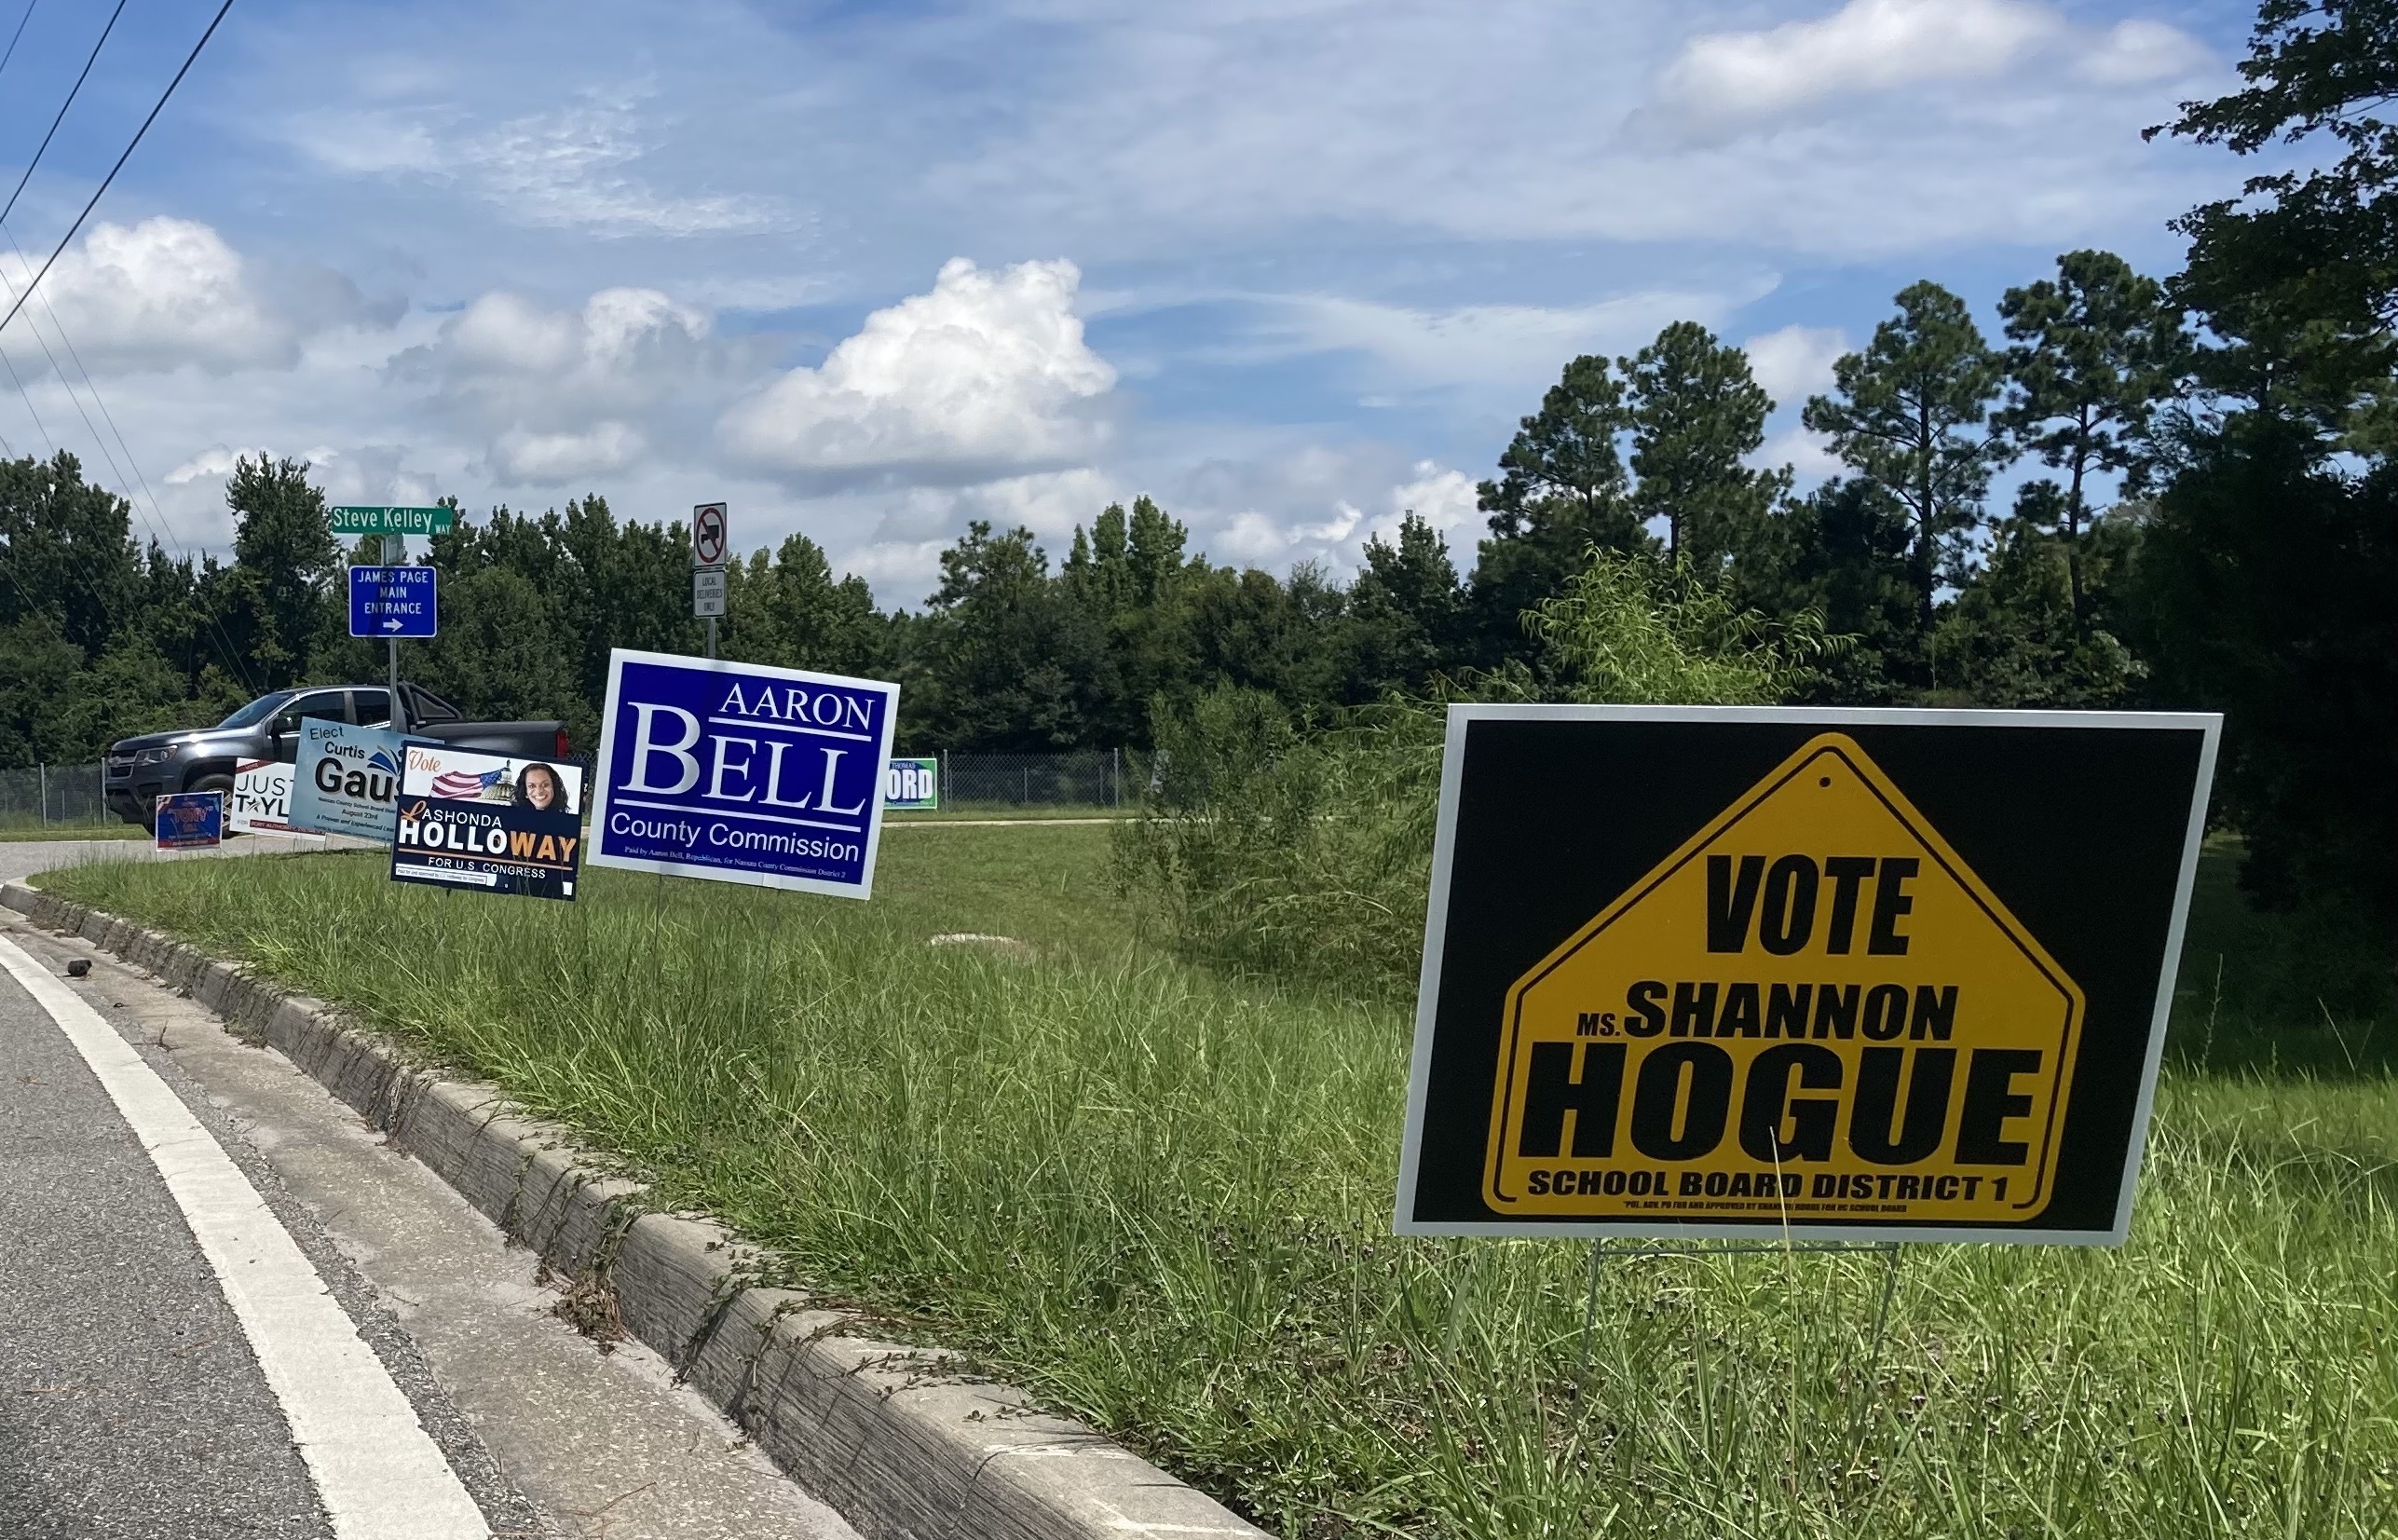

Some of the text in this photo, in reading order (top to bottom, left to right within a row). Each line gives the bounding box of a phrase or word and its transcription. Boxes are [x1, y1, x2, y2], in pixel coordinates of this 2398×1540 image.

[334, 508, 451, 534] Steve Kelley WAY
[358, 571, 429, 583] JAMES PAGE
[380, 587, 407, 598] MAIN
[364, 602, 422, 615] ENTRANCE
[718, 683, 876, 730] AARON
[309, 726, 344, 740] Elect
[325, 742, 365, 759] Curtis
[408, 750, 442, 772] Vote
[618, 702, 866, 816] BELL
[401, 800, 502, 827] LASHONDA
[399, 819, 577, 863] HOLLOWAY
[610, 812, 859, 862] County Commission
[624, 846, 638, 854] Paid
[640, 847, 648, 855] by
[428, 857, 452, 867] FOR
[483, 863, 546, 879] CONGRESS
[1706, 854, 1920, 956] VOTE
[1577, 980, 1959, 1042] MS. SHANNON
[1518, 1042, 2043, 1165] HOGUE
[1528, 1170, 2008, 1202] SCHOOL BOARD DISTRICT 1
[1705, 1202, 1745, 1210] APPROVED
